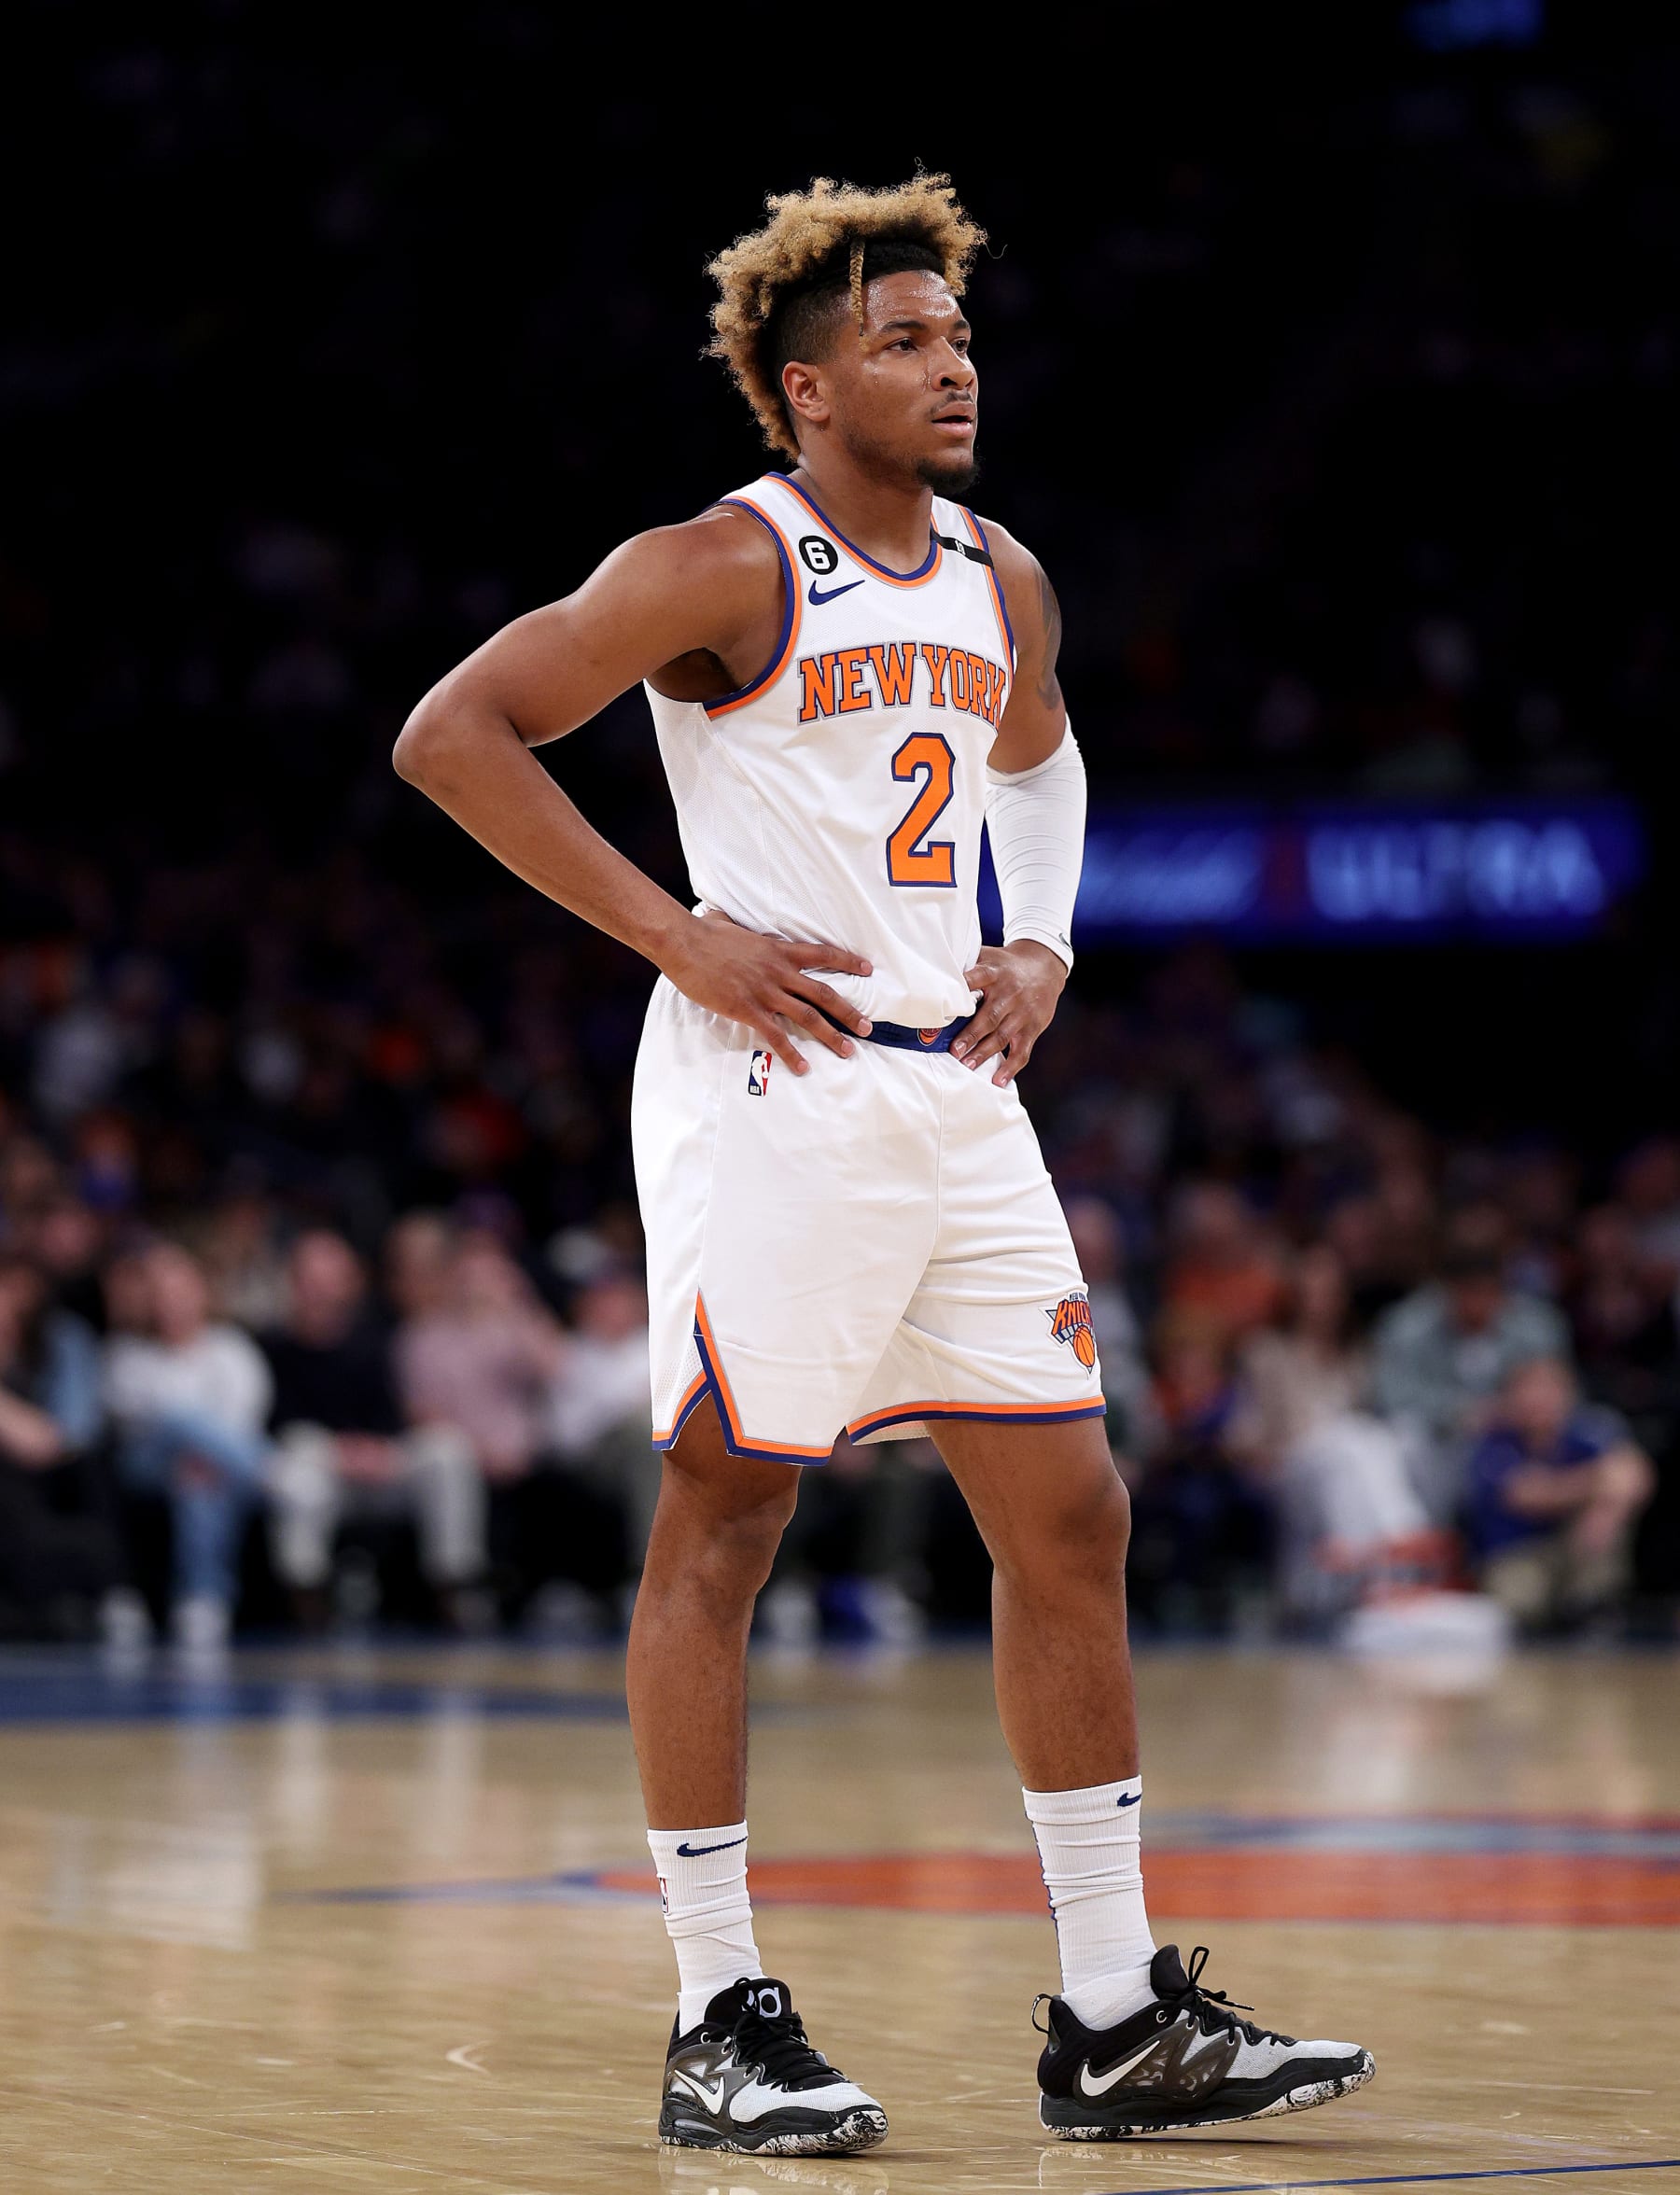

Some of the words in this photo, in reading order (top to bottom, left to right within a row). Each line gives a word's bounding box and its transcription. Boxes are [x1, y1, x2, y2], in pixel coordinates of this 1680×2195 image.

[805, 540, 832, 570] 6
[798, 641, 918, 724] NEW
[920, 642, 1007, 732] YORK
[886, 732, 958, 888] 2
[1051, 1299, 1093, 1336] KNIC
